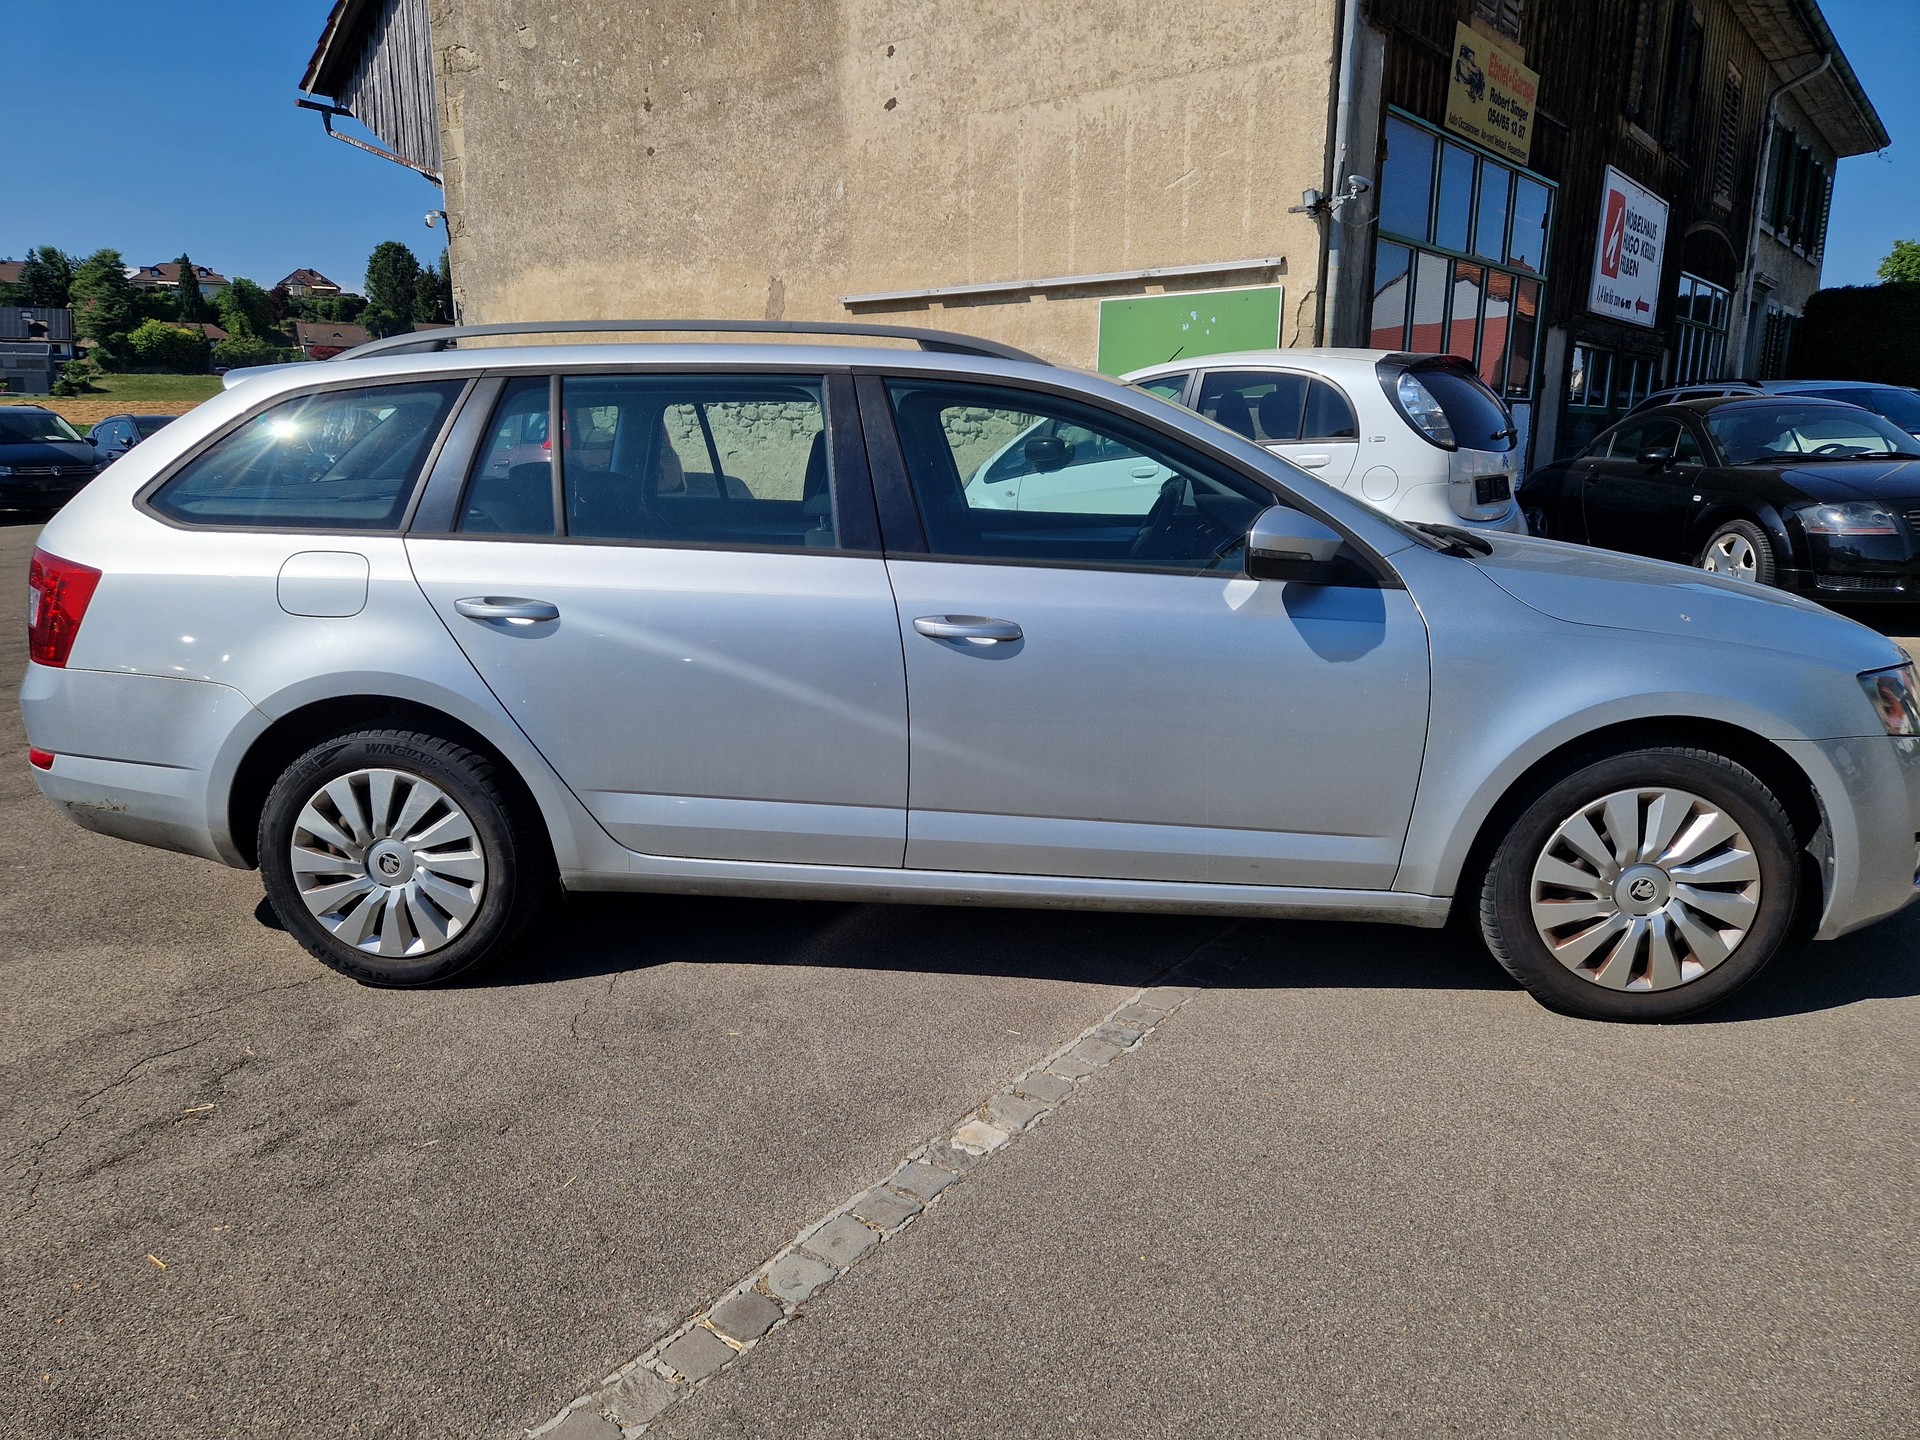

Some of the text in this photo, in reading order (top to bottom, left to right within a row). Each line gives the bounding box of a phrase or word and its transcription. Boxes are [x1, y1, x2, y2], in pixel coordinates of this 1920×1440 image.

[1490, 87, 1528, 121] Robert Singer
[1488, 107, 1526, 139] 054/65 13 87
[1625, 206, 1657, 241] MÖBELHAUS
[1623, 231, 1640, 255] HUGO
[365, 743, 442, 768] WINGUARD
[311, 943, 392, 981] NEXEN
